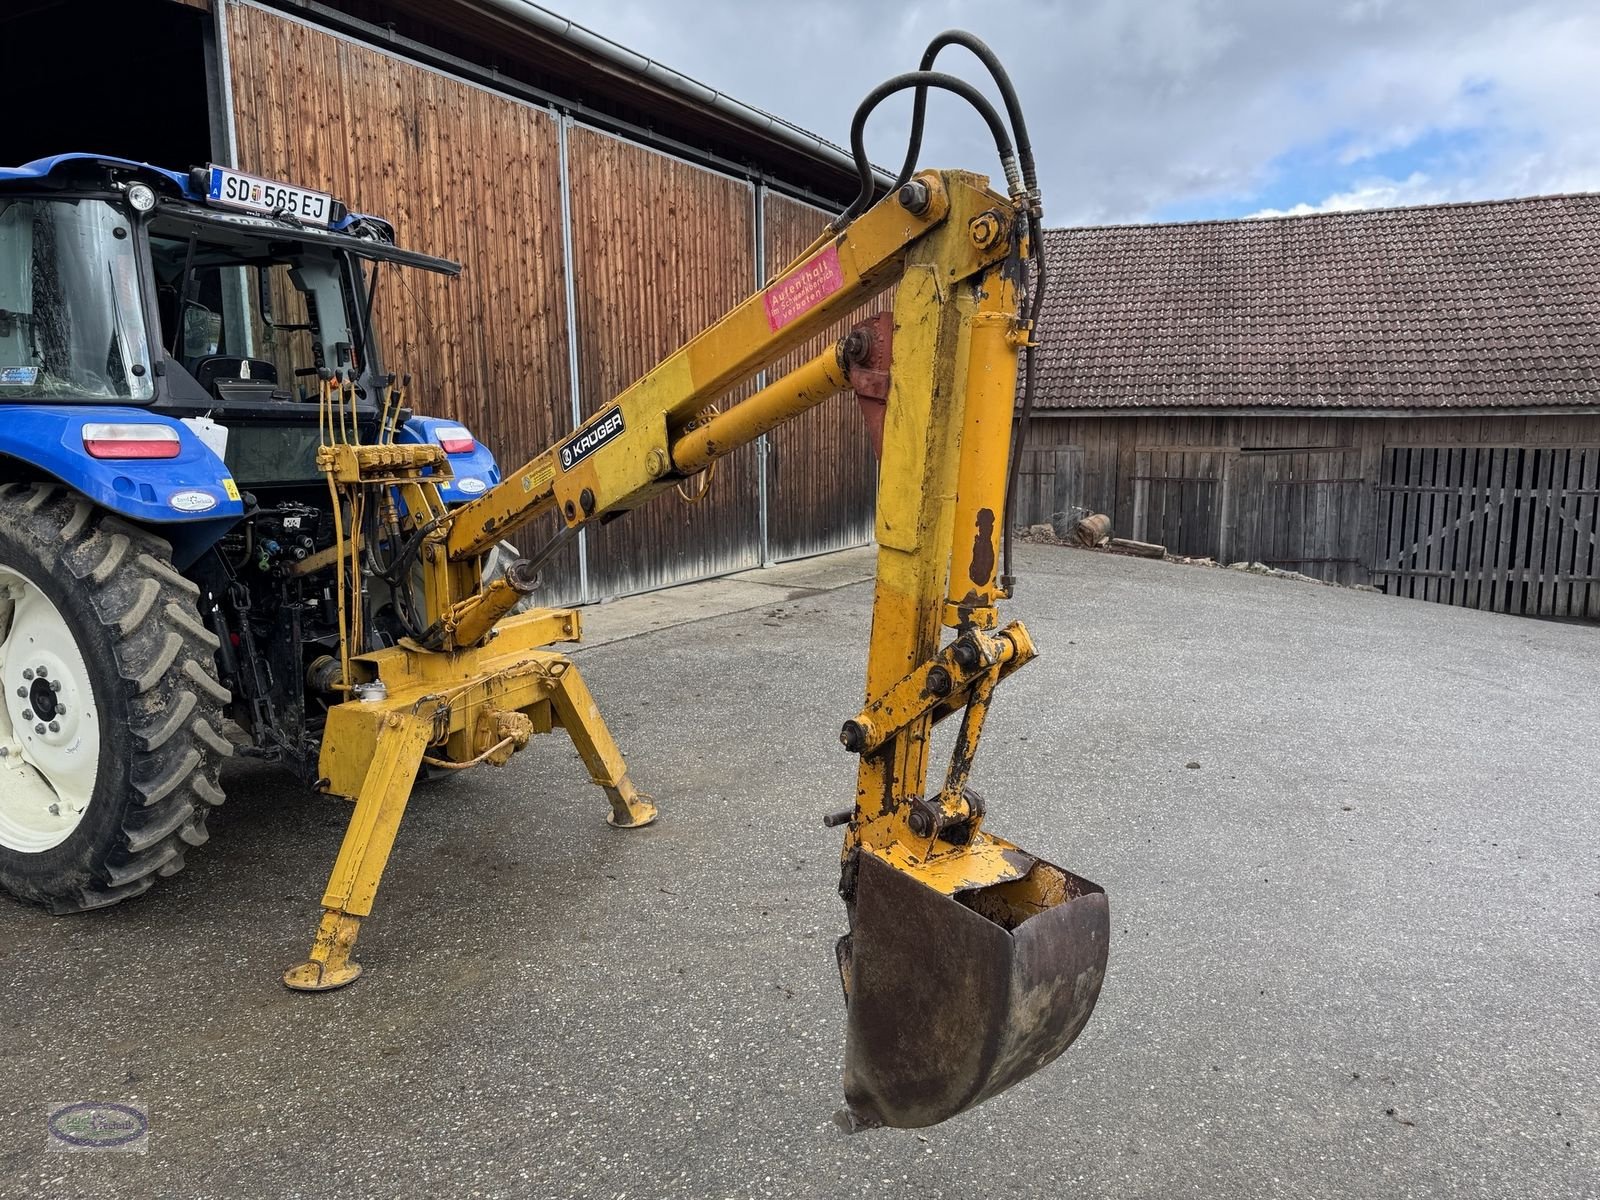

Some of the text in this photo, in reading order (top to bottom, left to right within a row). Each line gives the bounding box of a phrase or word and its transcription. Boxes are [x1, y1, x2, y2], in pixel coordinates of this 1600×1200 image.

[226, 176, 323, 218] SD 565 EJ
[771, 260, 828, 306] Aufenthalt
